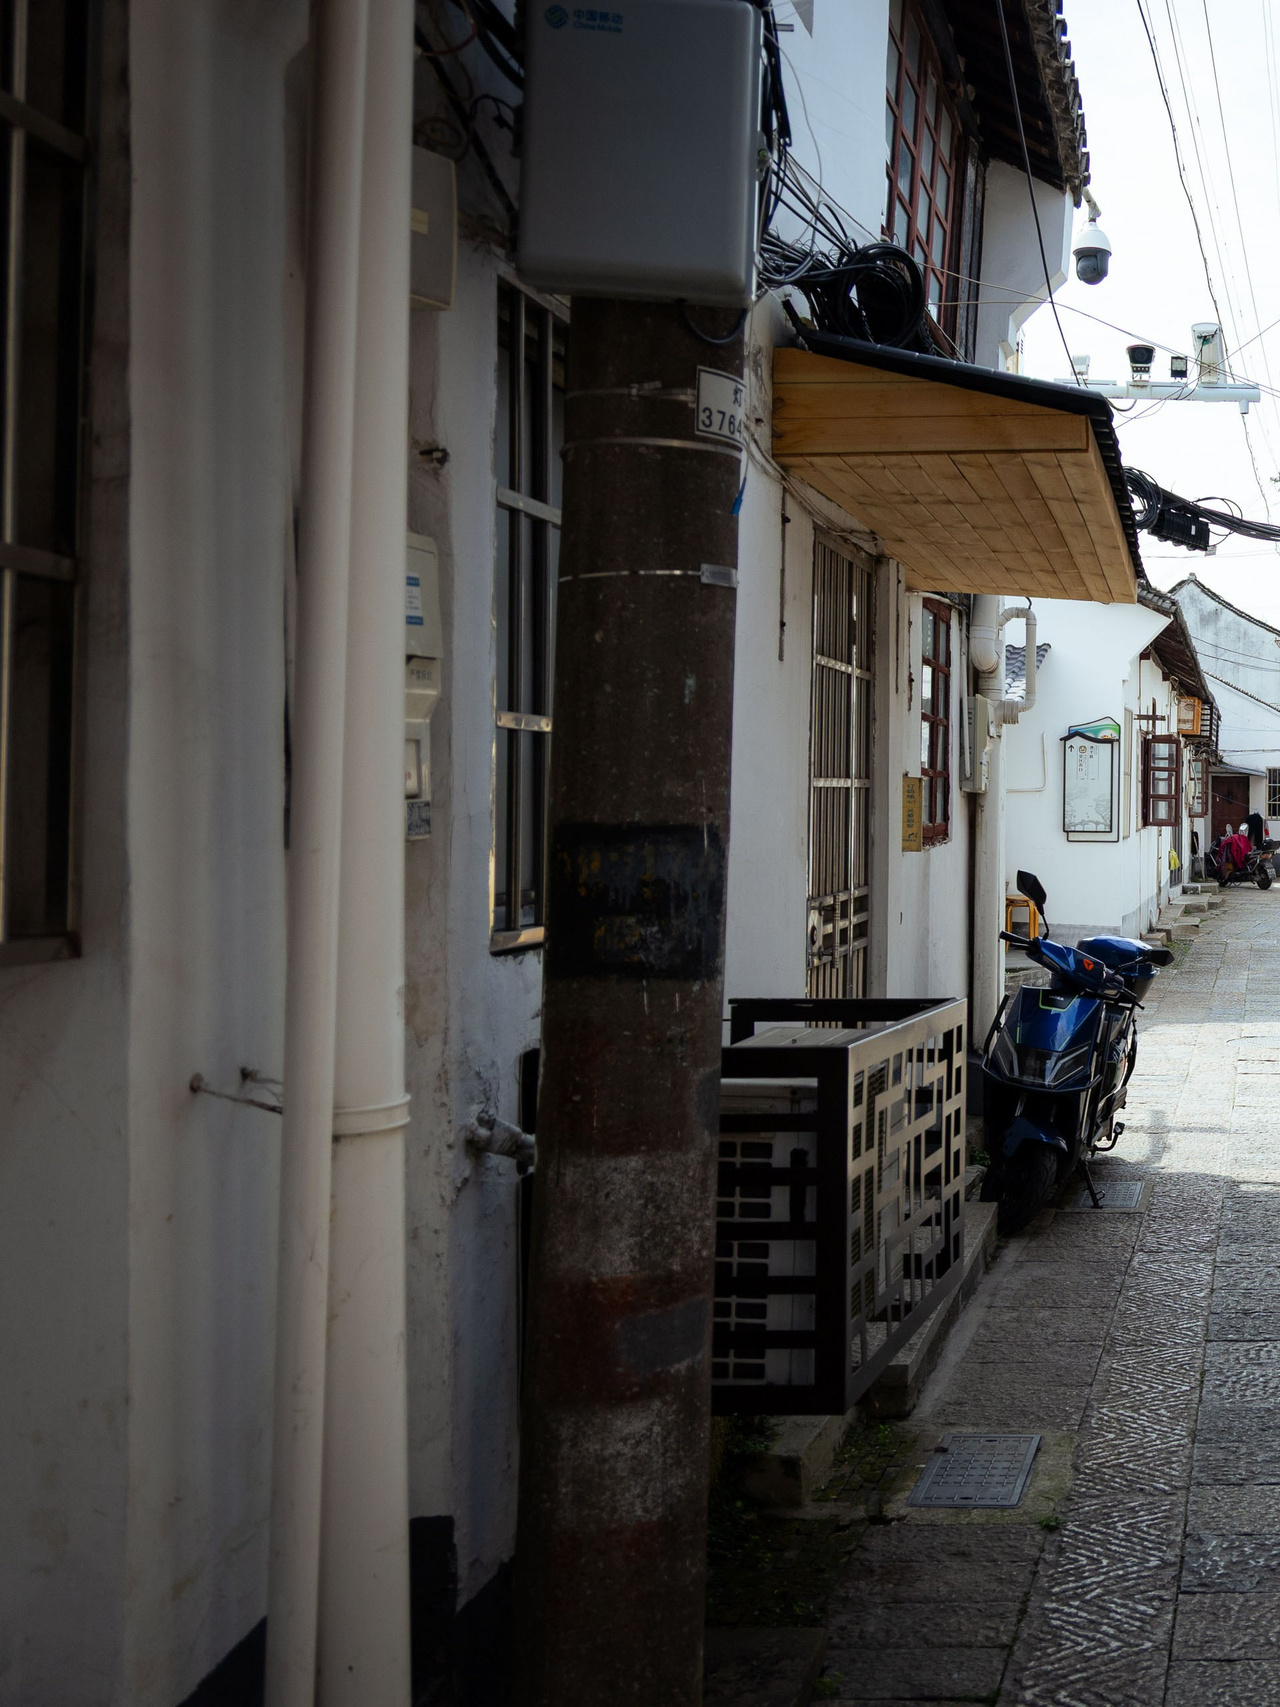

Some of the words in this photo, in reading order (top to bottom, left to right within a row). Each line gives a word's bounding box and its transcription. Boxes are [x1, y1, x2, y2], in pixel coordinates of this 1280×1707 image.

[573, 9, 624, 24] 中国移动
[732, 384, 743, 407] 灯
[701, 406, 743, 438] 3764
